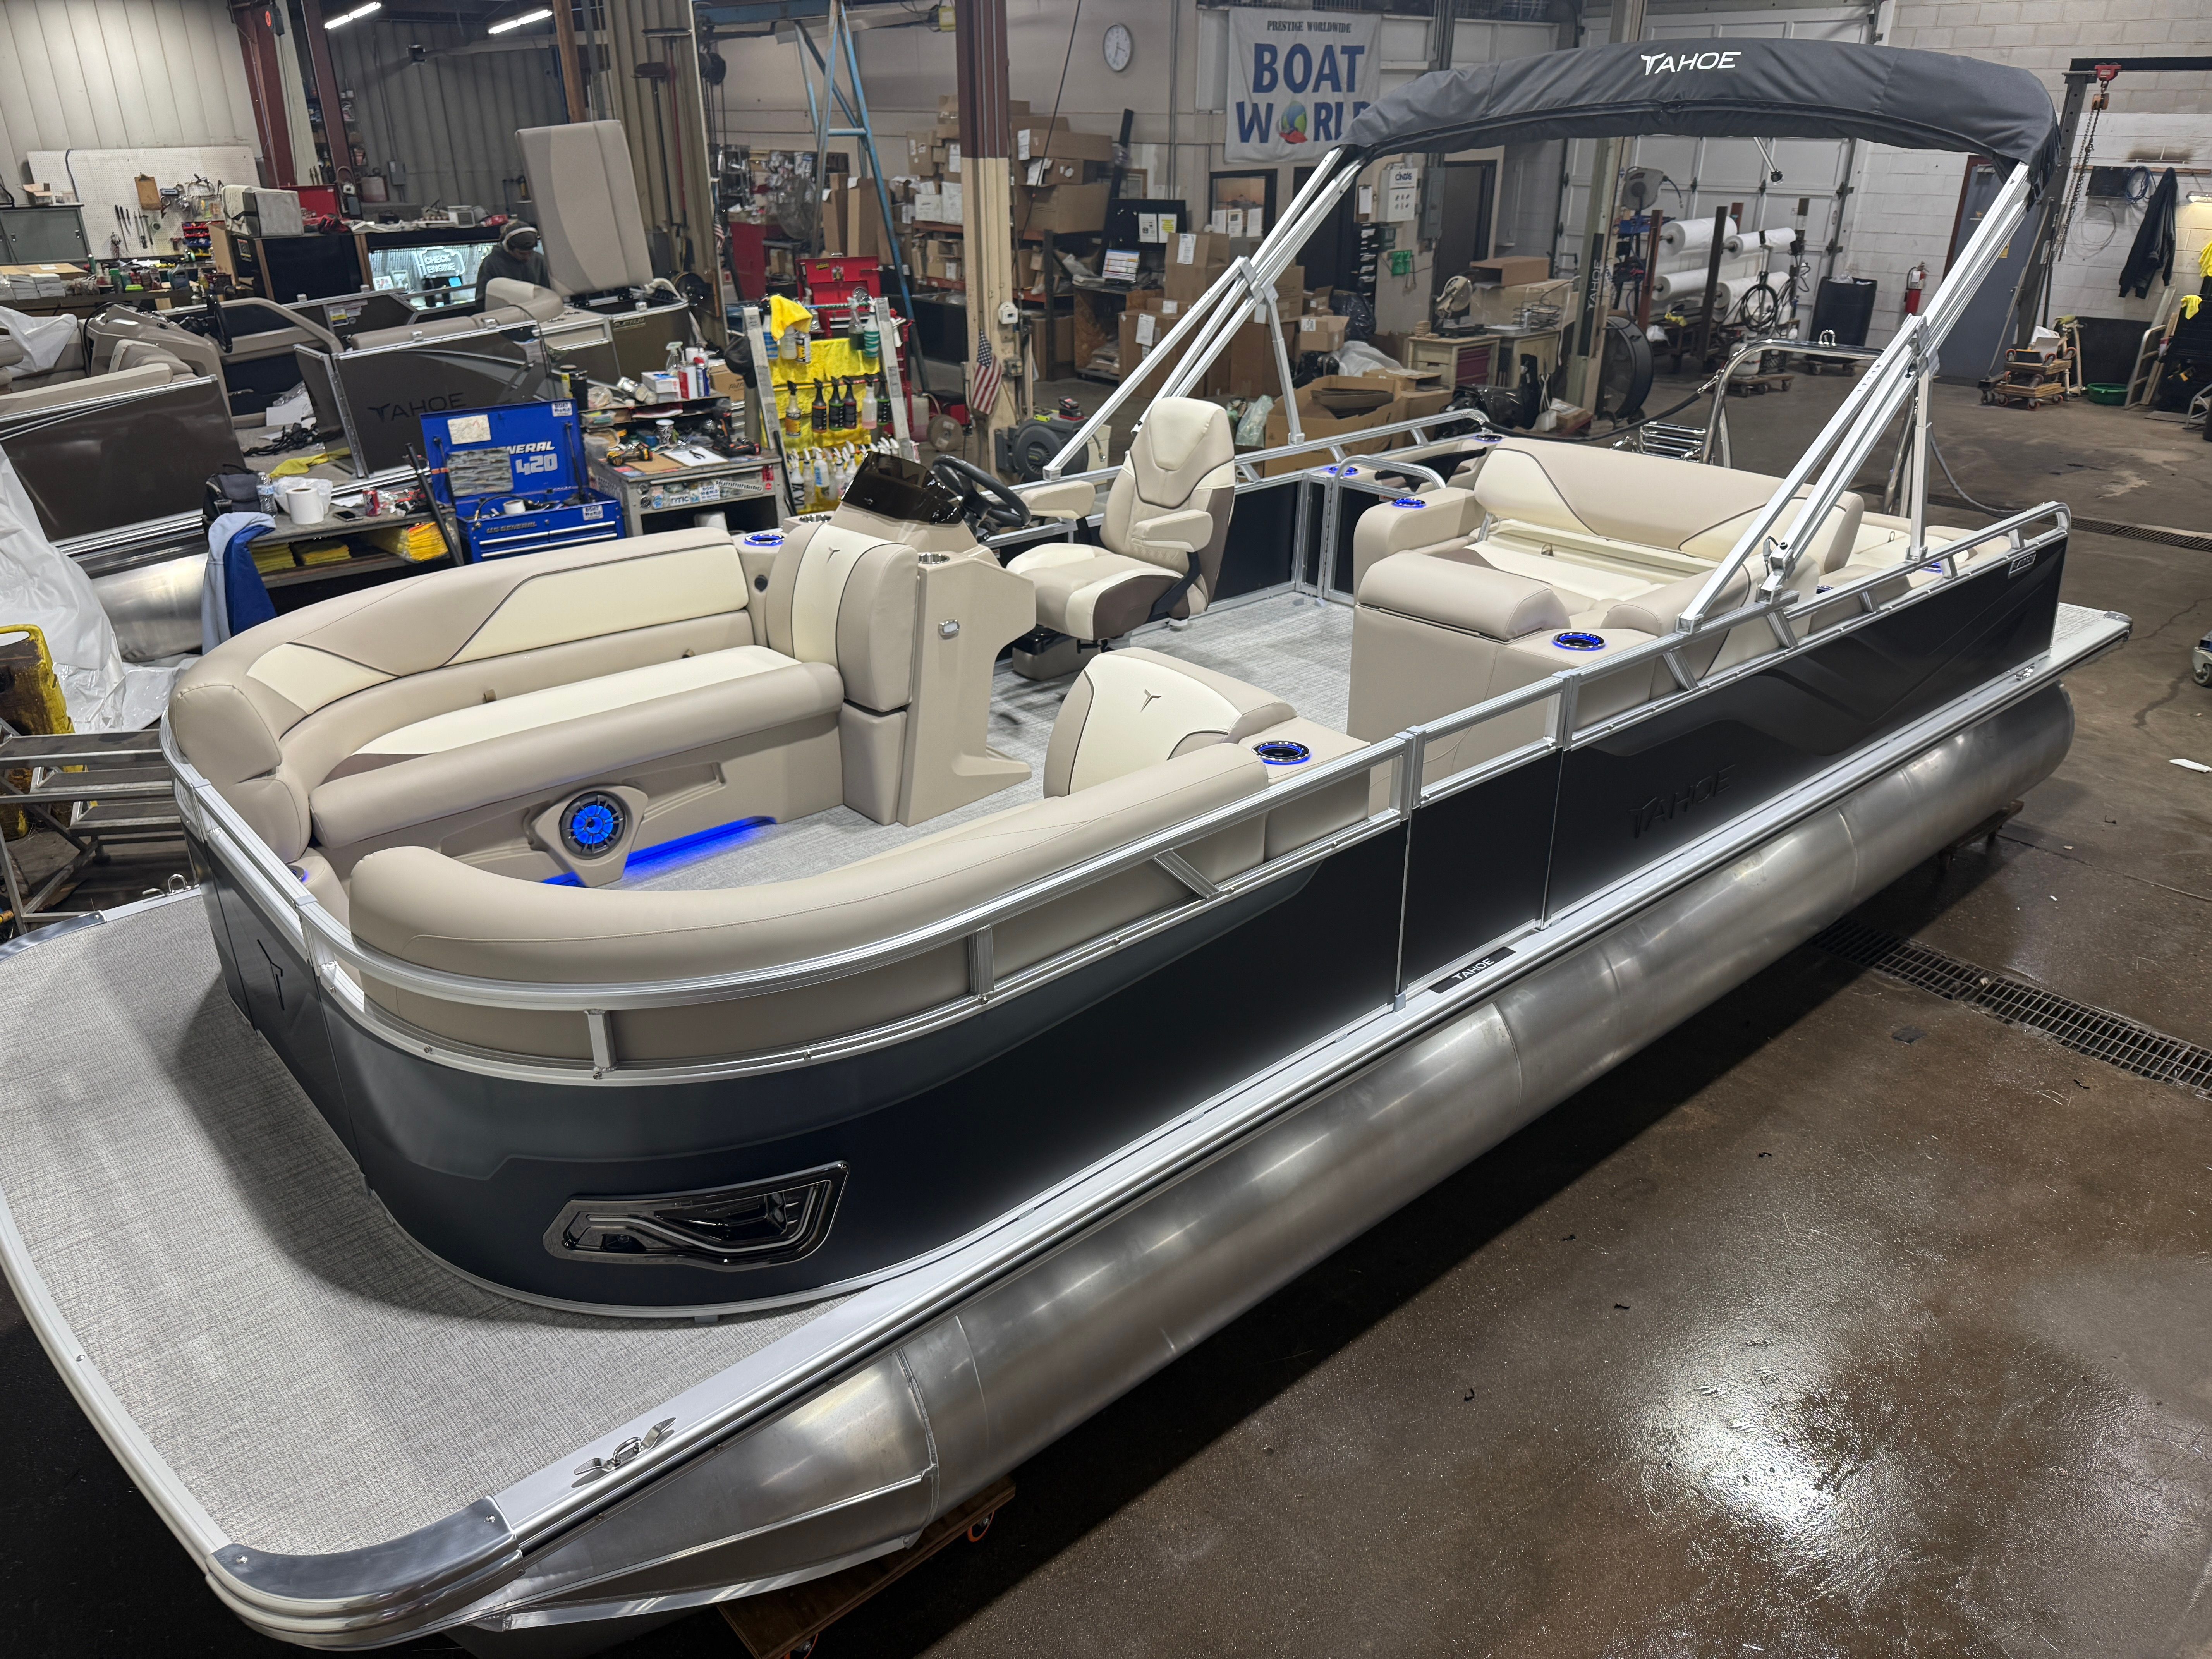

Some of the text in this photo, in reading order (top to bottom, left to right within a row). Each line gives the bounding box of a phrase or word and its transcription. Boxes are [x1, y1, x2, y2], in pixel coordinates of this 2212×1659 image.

[1267, 21, 1351, 33] PRESTIGE WORLDWIDE
[1252, 43, 1364, 93] BOAT
[1641, 52, 1741, 75] TAHOE
[424, 254, 451, 264] CHECK
[426, 262, 456, 273] ENGINE
[1587, 259, 1601, 311] TAHOE
[368, 392, 466, 422] TAHOE
[515, 453, 558, 475] 420
[1626, 764, 1735, 839] TAHOE
[1451, 958, 1495, 979] TAHOE
